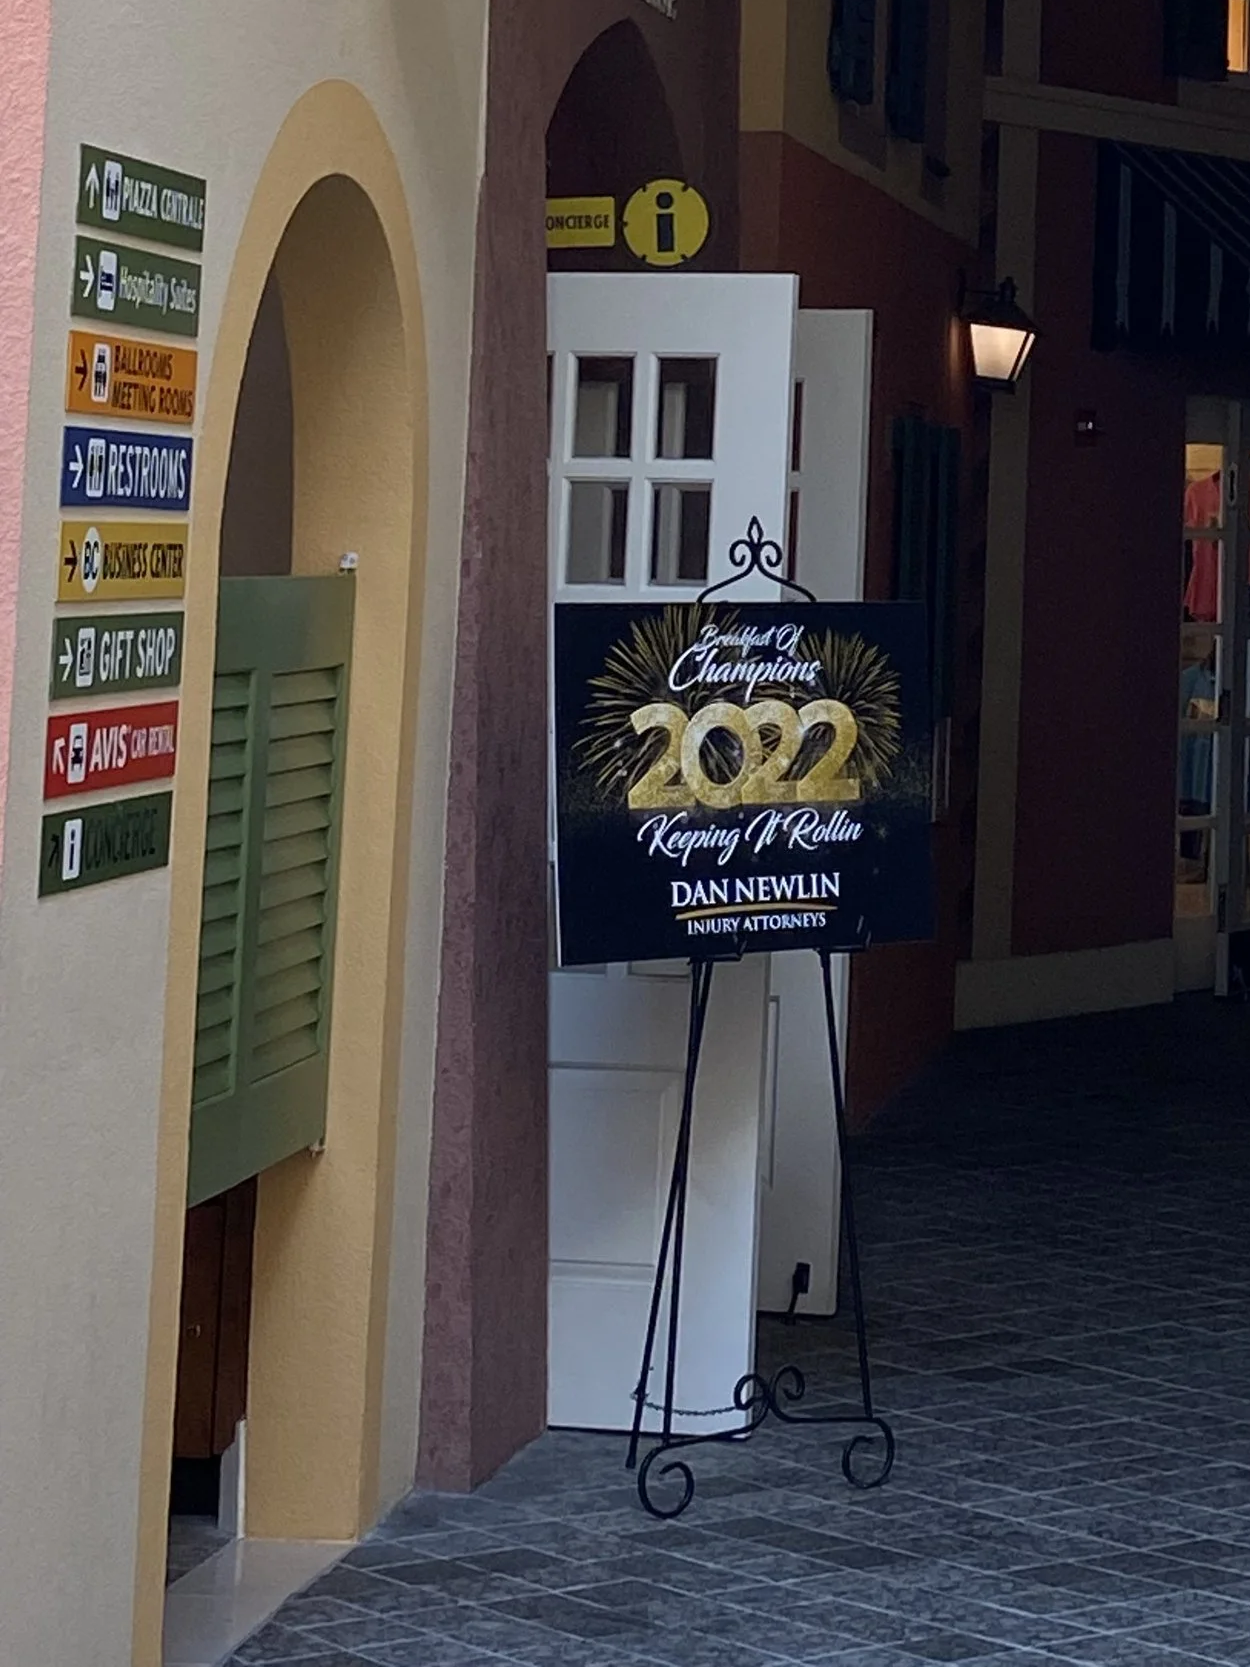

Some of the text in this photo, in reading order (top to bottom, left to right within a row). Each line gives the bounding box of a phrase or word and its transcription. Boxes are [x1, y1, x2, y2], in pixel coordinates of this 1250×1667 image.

[122, 176, 204, 230] PIAZZA CENTRALE
[545, 214, 610, 231] ONCIERGE
[119, 265, 197, 315] Hospitality Suites
[114, 345, 173, 381] BALLROOMS
[111, 380, 194, 418] MEETING ROOMS
[107, 443, 187, 500] RESTROOMS
[83, 540, 184, 580] BC BUSINESS CENTER
[100, 627, 176, 682] GIFT SHOP
[695, 623, 805, 654] Breakfast Of
[668, 642, 824, 703] Champions
[89, 723, 175, 772] AVIS CAR RENTAL
[628, 698, 862, 810] 2022
[637, 807, 864, 867] Keeping It Rollin
[670, 872, 841, 908] DAN NEWLIN
[687, 912, 827, 935] INJURY ATTORNEYS
